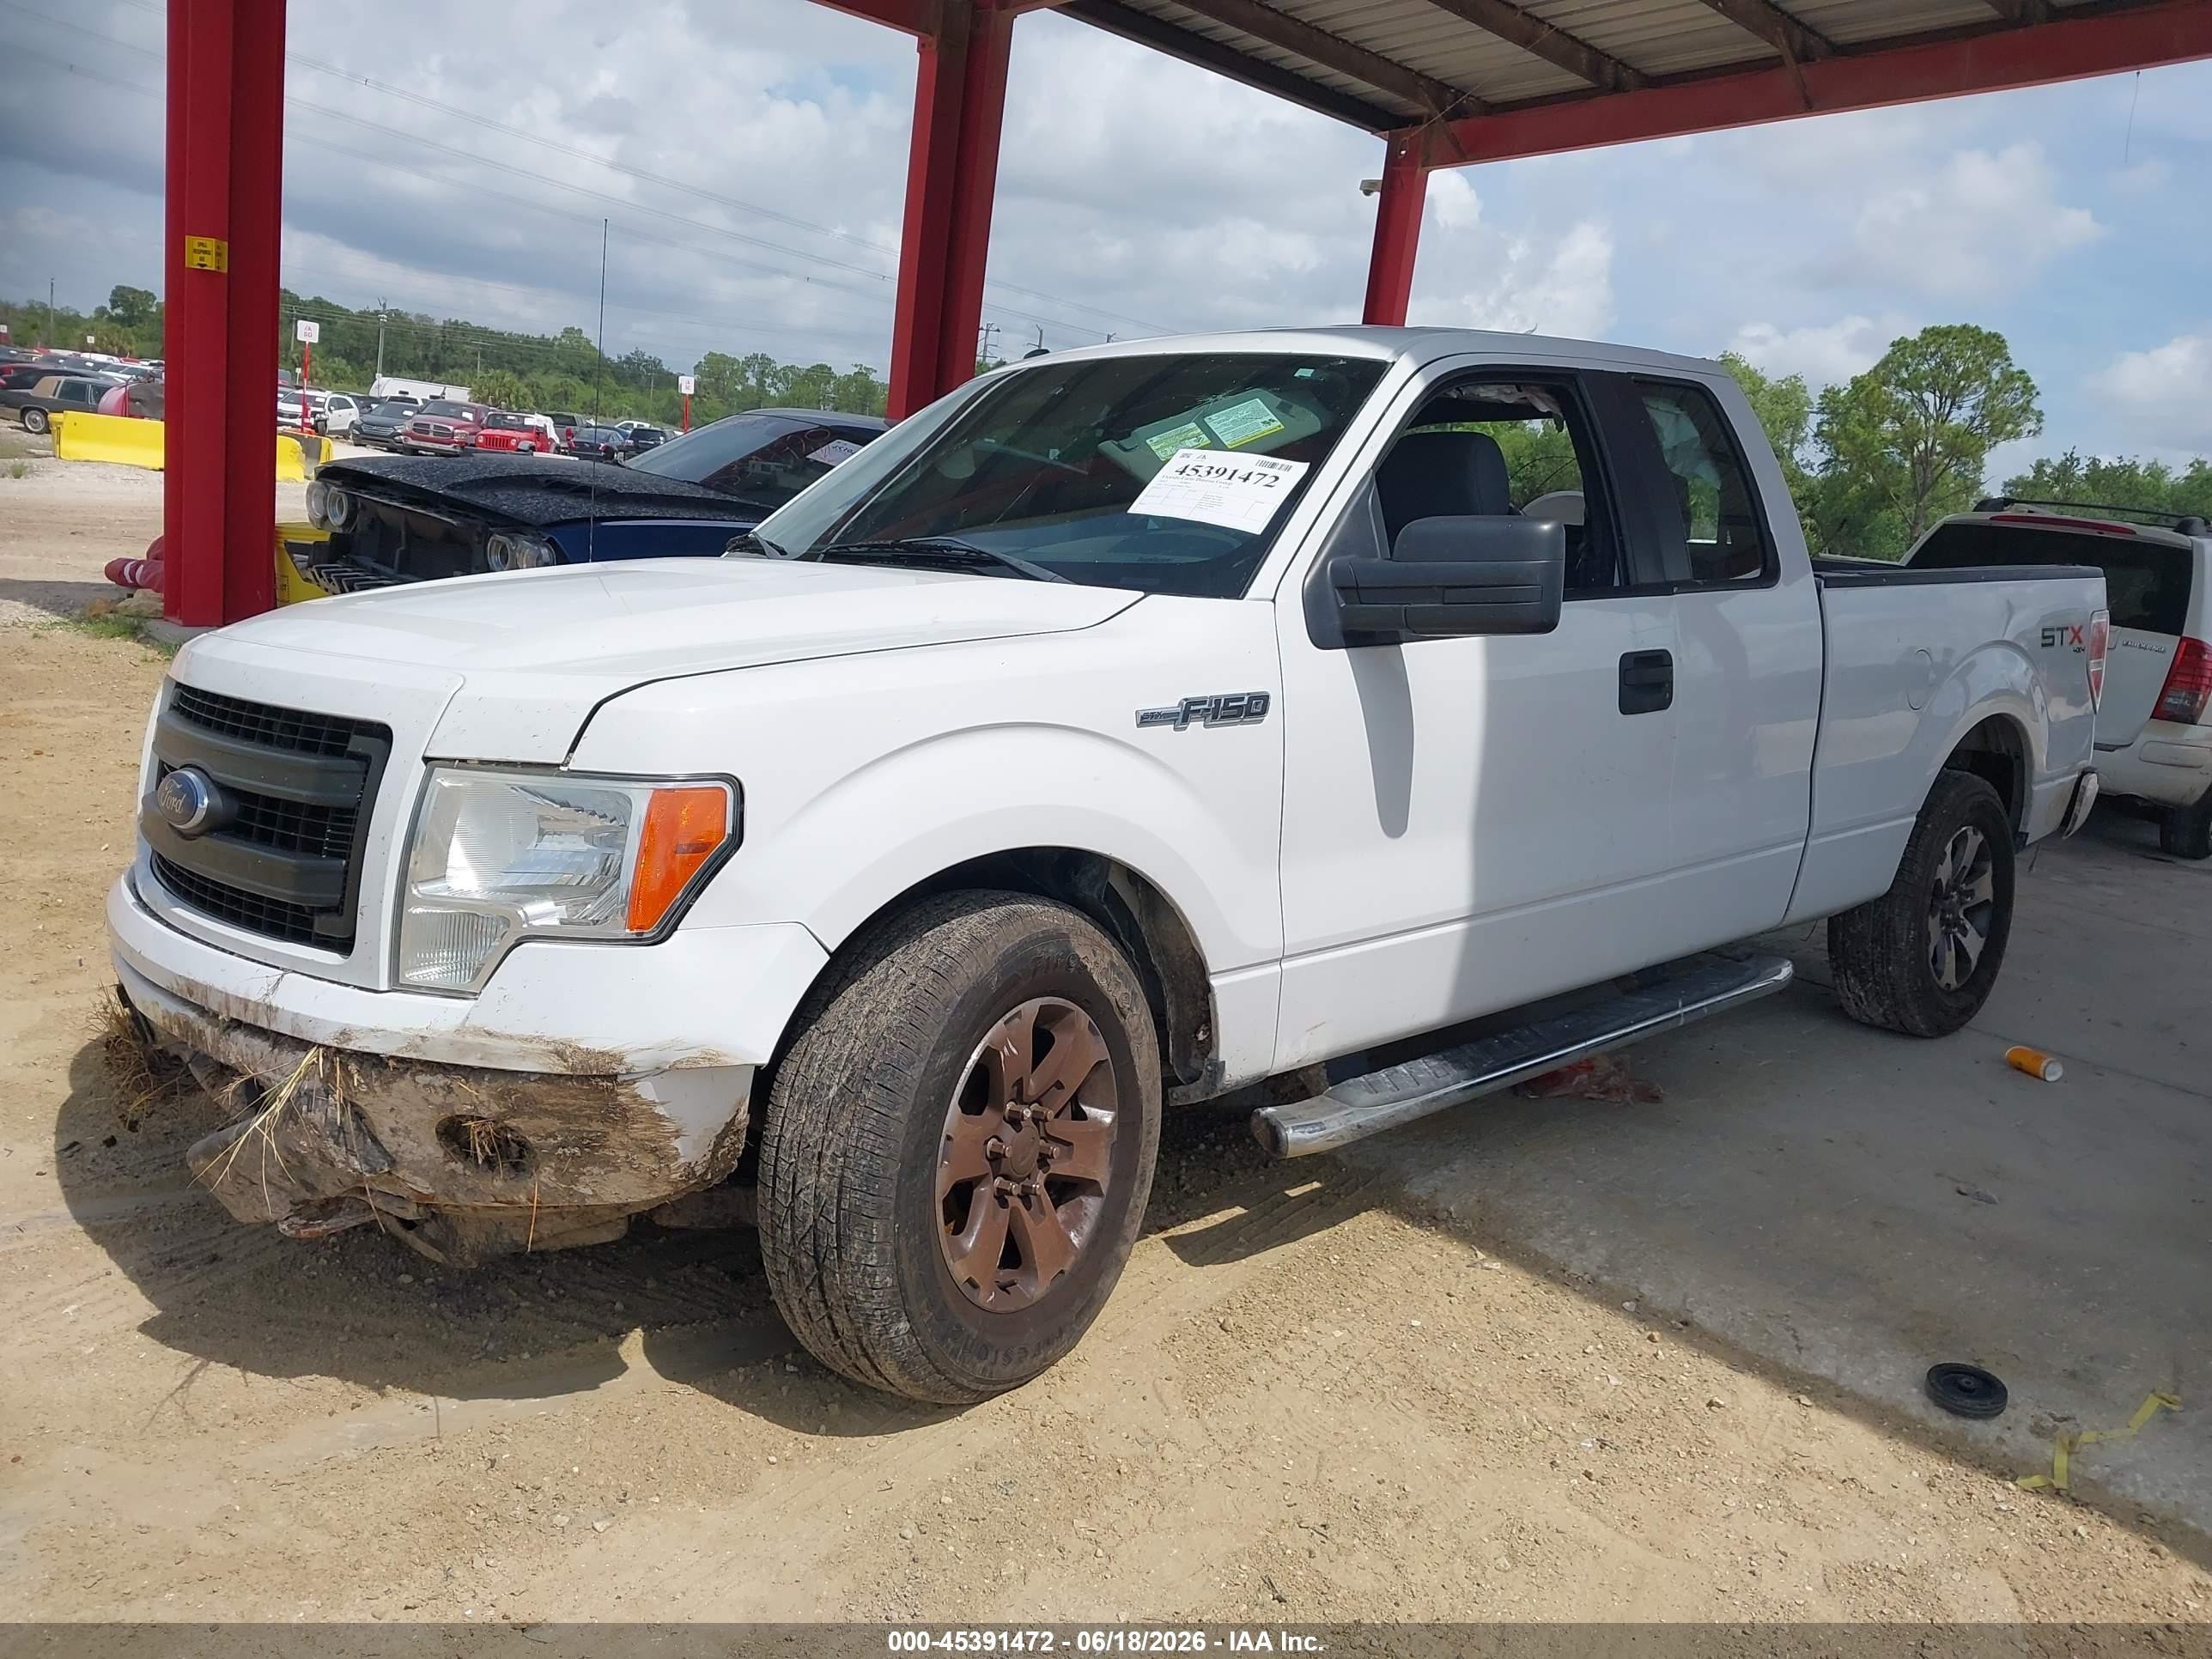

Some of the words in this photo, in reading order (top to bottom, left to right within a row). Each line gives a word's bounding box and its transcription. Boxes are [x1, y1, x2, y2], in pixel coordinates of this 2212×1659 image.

[1175, 464, 1279, 488] 45391472
[2041, 625, 2083, 647] STX
[1179, 693, 1271, 726] F-150
[161, 778, 187, 814] Ford
